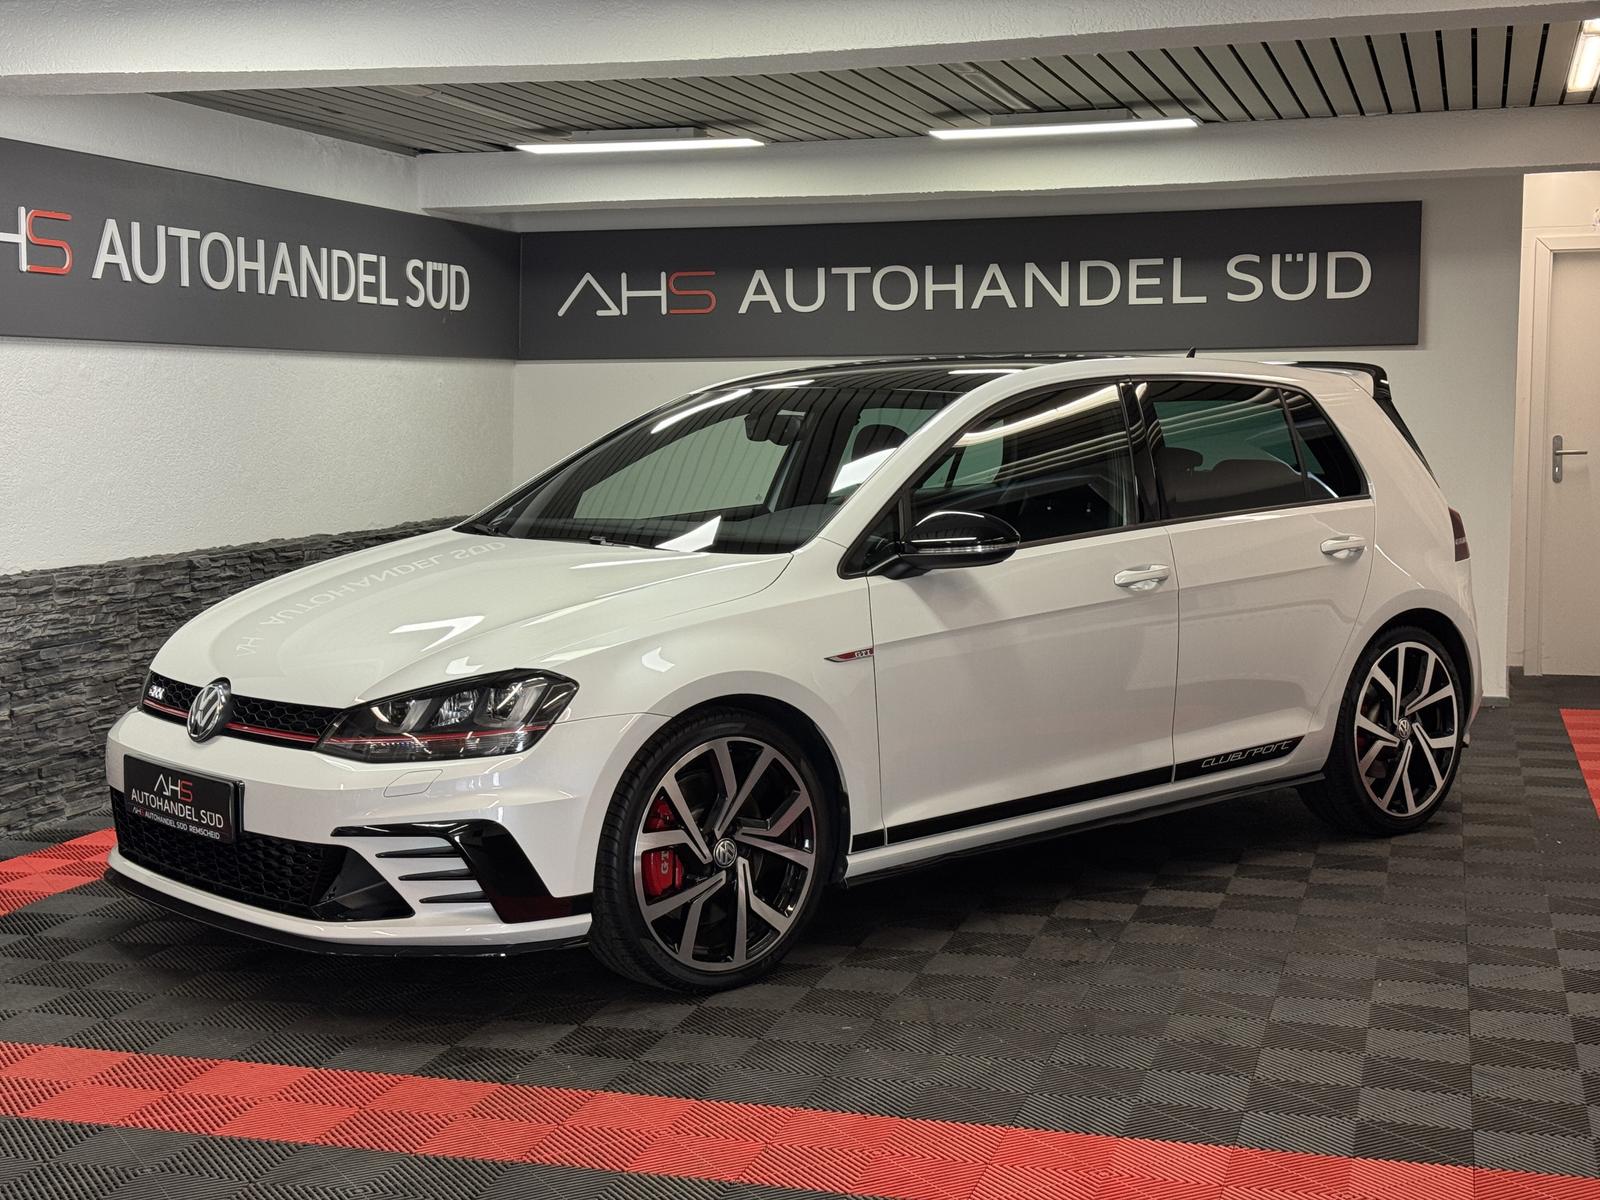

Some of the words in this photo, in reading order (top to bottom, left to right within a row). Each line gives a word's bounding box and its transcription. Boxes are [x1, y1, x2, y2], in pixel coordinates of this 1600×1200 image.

[91, 218, 400, 307] AUTOHANDEL
[405, 258, 471, 312] SÜD
[557, 271, 717, 317] AHS
[738, 258, 1207, 314] AUTOHANDEL
[1225, 251, 1372, 303] SÜD
[1201, 740, 1293, 768] CLUBSPORT
[154, 773, 193, 802] AHS
[131, 788, 199, 822] AUTOHANDEL
[200, 809, 224, 828] SÜD
[145, 811, 176, 829] AUTOHANDEL
[189, 825, 220, 840] REMSCHEID
